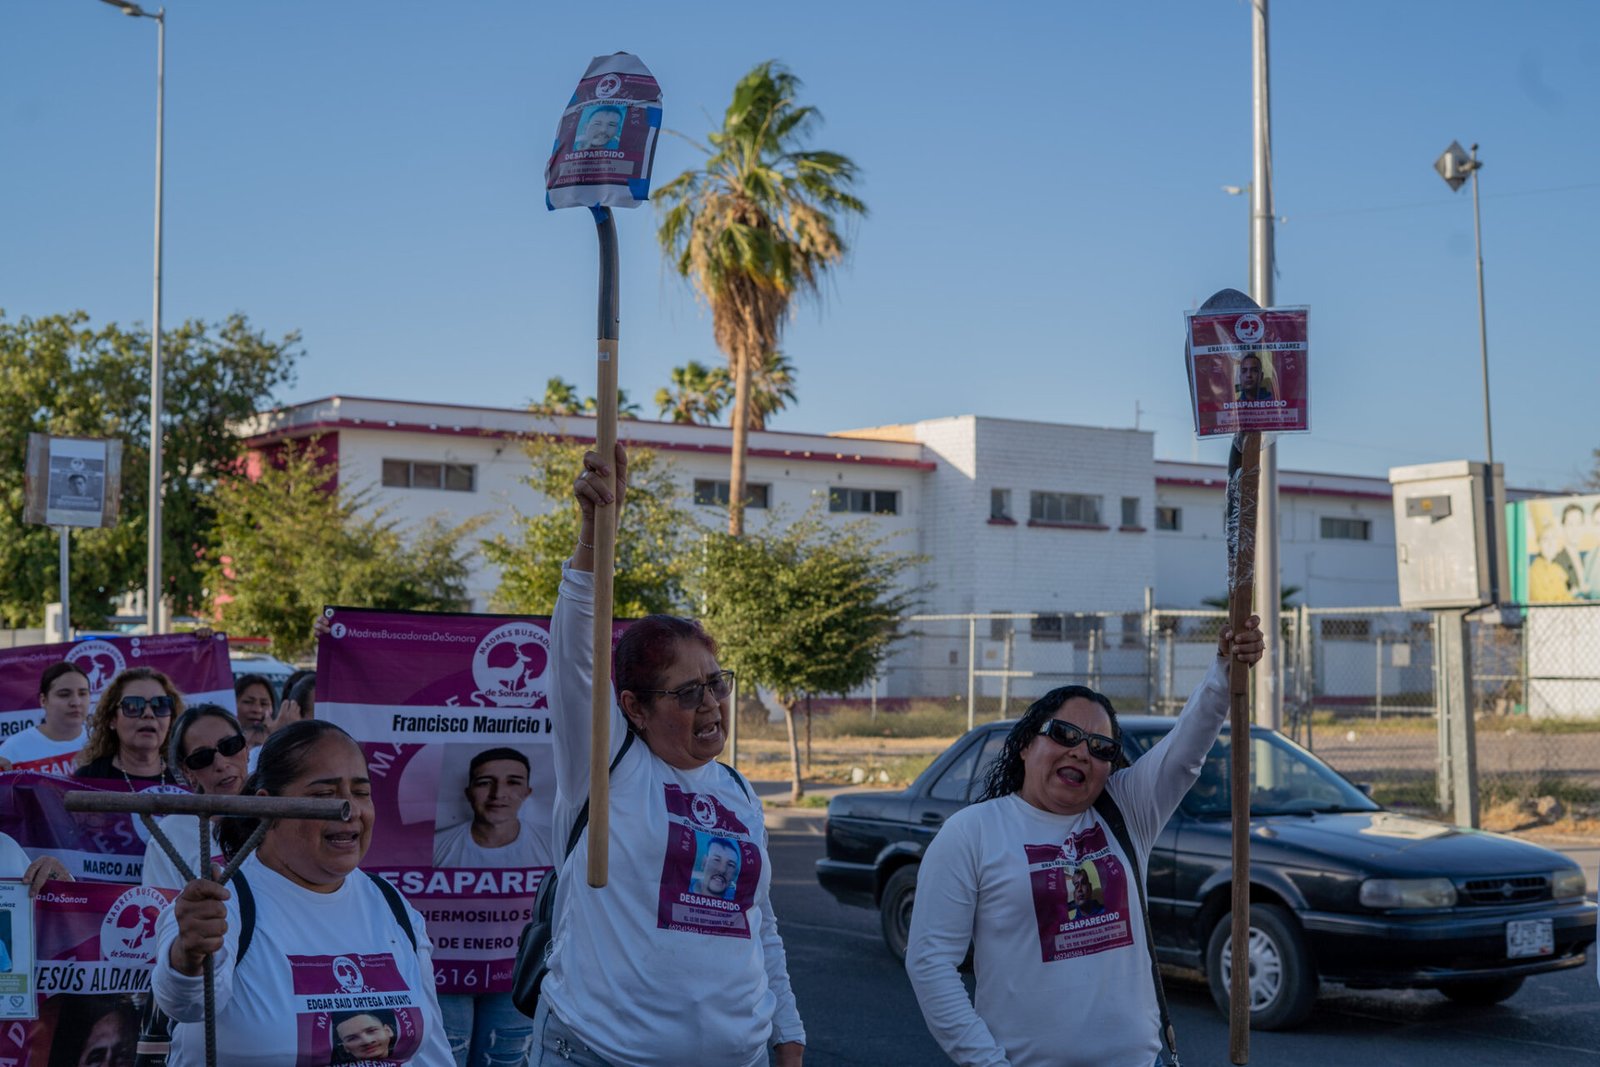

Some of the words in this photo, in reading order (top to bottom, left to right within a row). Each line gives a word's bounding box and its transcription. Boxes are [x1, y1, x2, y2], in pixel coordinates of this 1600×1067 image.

[564, 150, 625, 160] DESAPARECIDO
[348, 628, 476, 643] MadresBuscadorasDeSonora
[478, 629, 512, 655] MADRES
[485, 688, 496, 697] de
[498, 689, 529, 698] Sonora
[392, 714, 469, 732] Francisco
[472, 715, 540, 733] Mauricio
[83, 859, 122, 876] MARCO
[106, 890, 133, 925] MADRES
[680, 892, 740, 911] DESAPARECIDO
[1060, 912, 1120, 932] DESAPARECIDO
[438, 937, 460, 949] DE
[463, 936, 514, 950] ENERO
[307, 998, 334, 1010] EDGAR
[334, 998, 352, 1009] SAID
[353, 996, 384, 1008] ORTEGA
[384, 994, 412, 1006] ARVAYO
